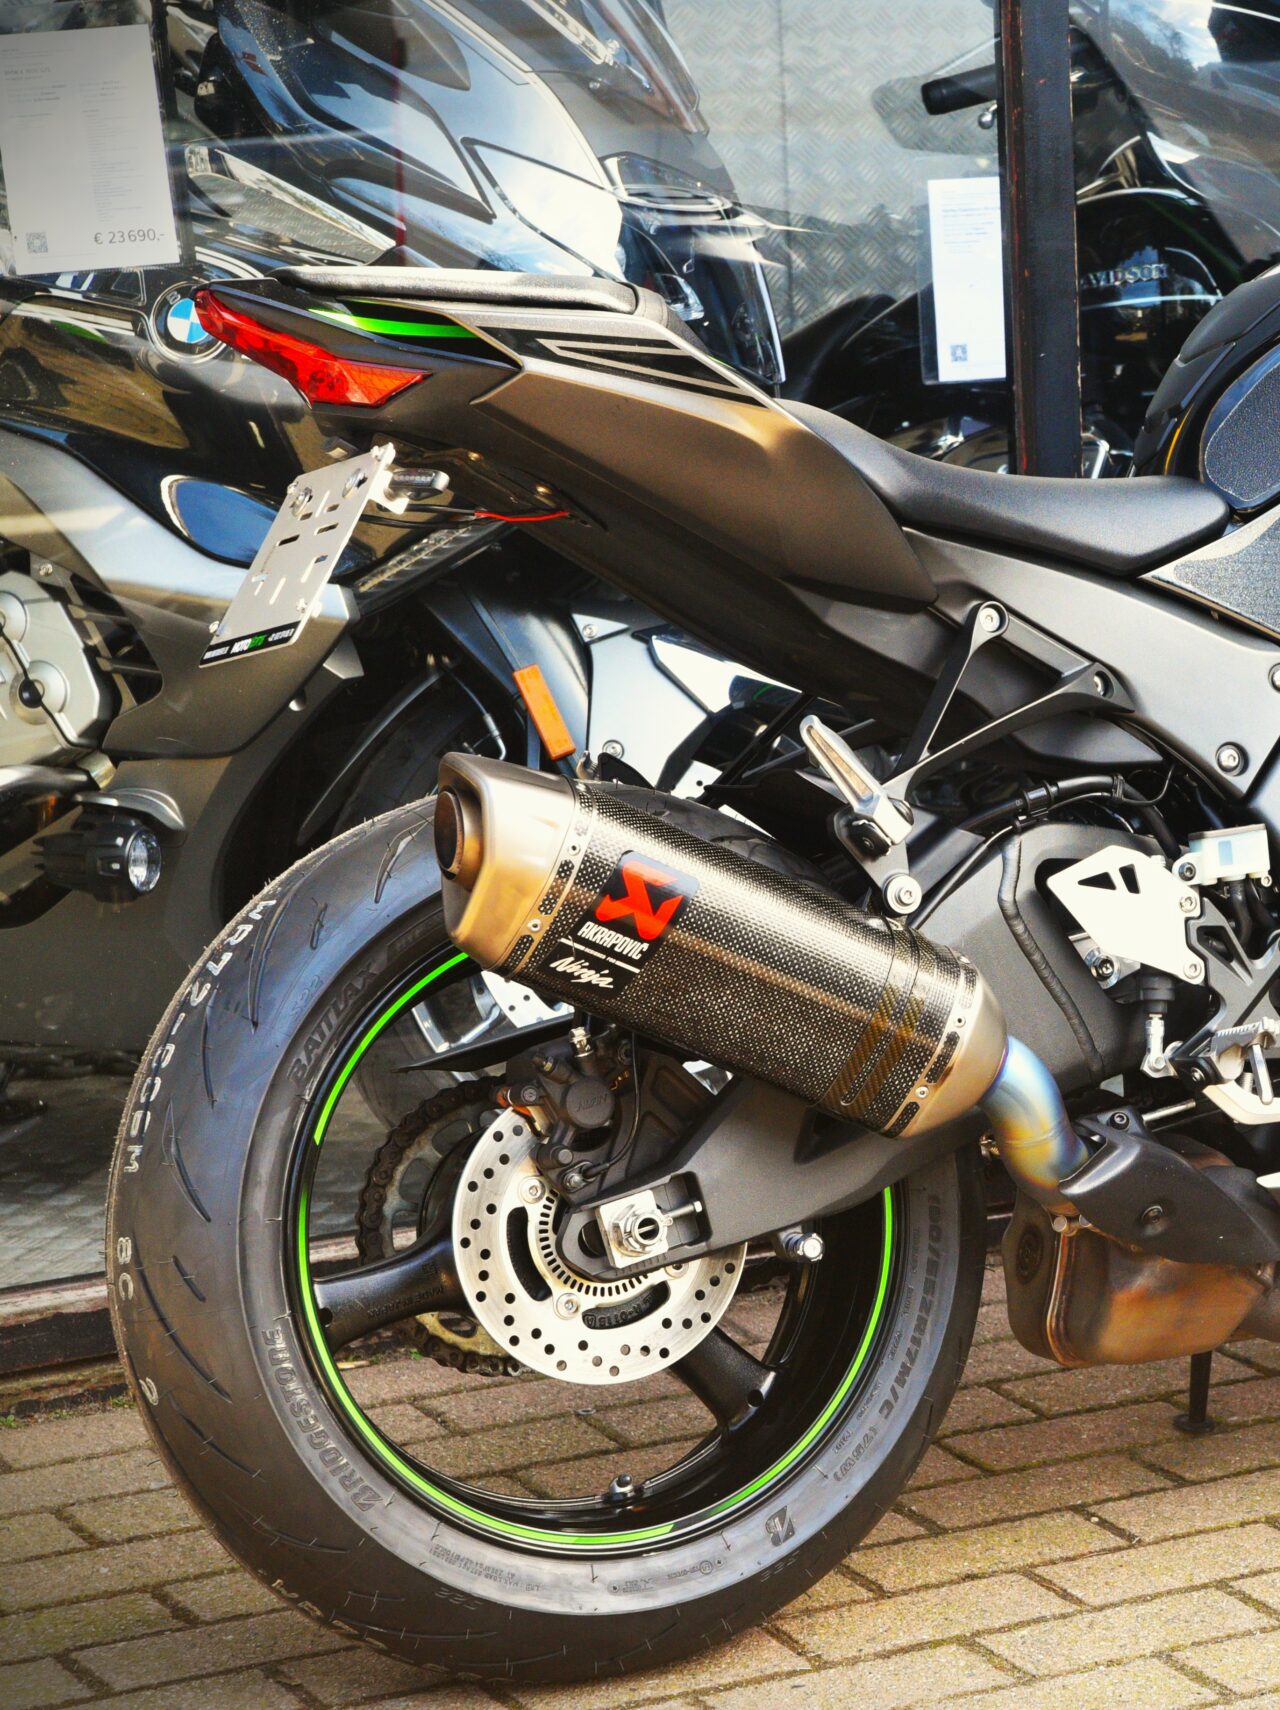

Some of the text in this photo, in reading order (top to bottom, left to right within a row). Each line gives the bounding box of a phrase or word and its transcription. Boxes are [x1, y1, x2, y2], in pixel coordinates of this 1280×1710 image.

[1080, 263, 1169, 288] AVIDSON
[549, 956, 614, 989] Ninja
[261, 1326, 384, 1512] BRIDGESTONE
